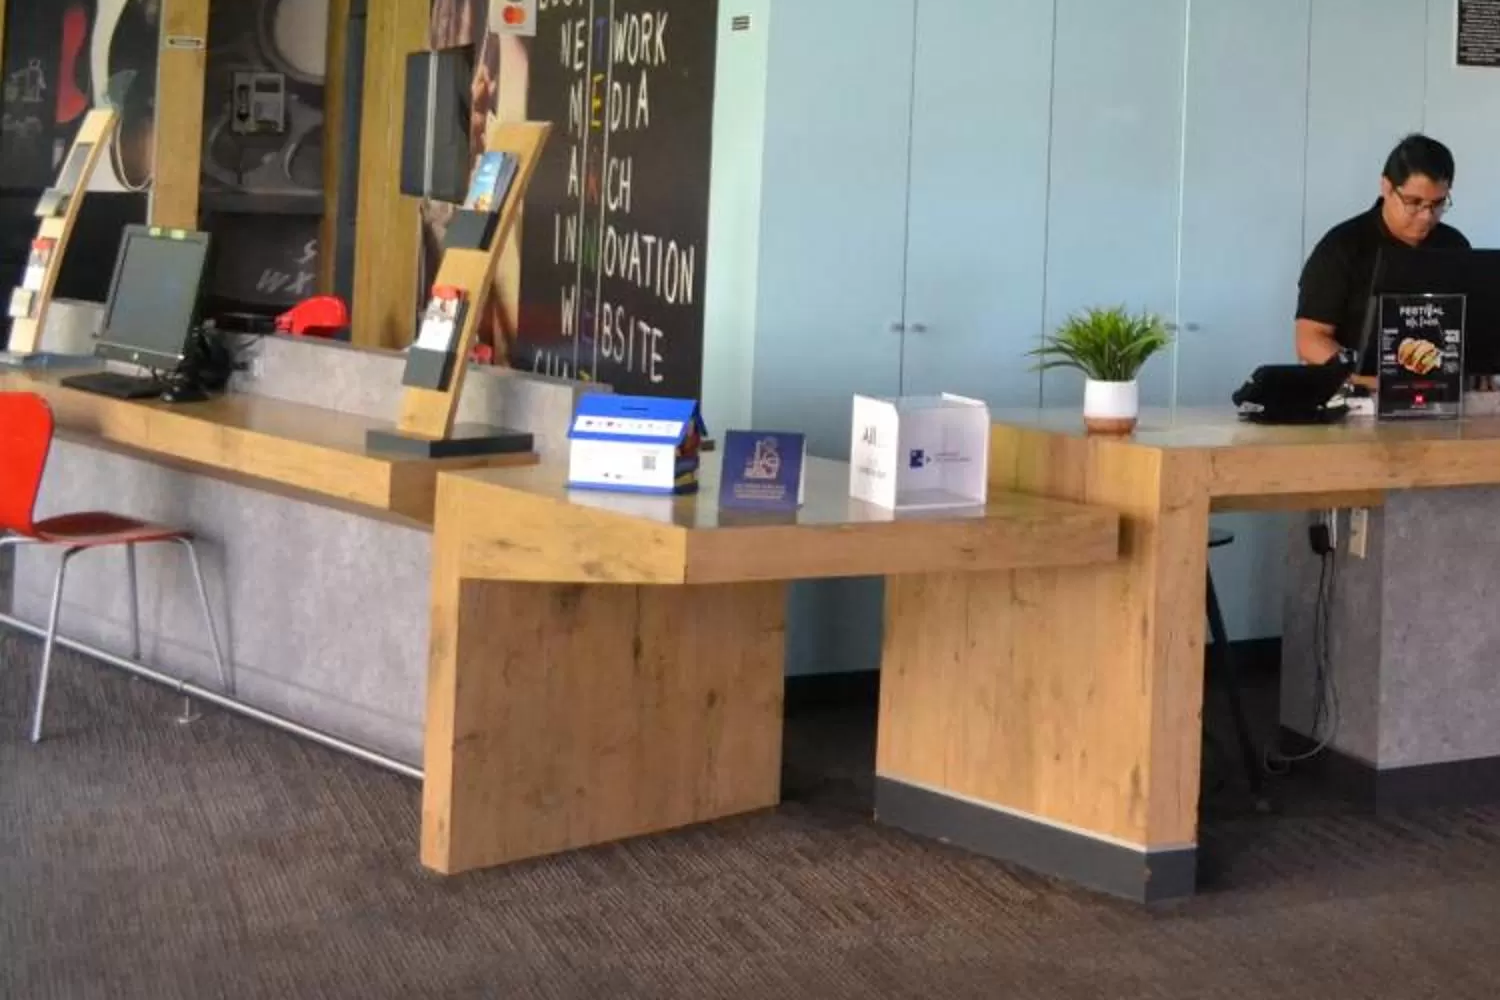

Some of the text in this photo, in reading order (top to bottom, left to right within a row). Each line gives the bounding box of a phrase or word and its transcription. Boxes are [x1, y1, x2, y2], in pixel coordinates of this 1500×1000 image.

[559, 11, 669, 71] NETWORK
[568, 68, 650, 140] MEDIA
[553, 213, 695, 305] INNOVATION
[561, 284, 664, 383] WEBSITE
